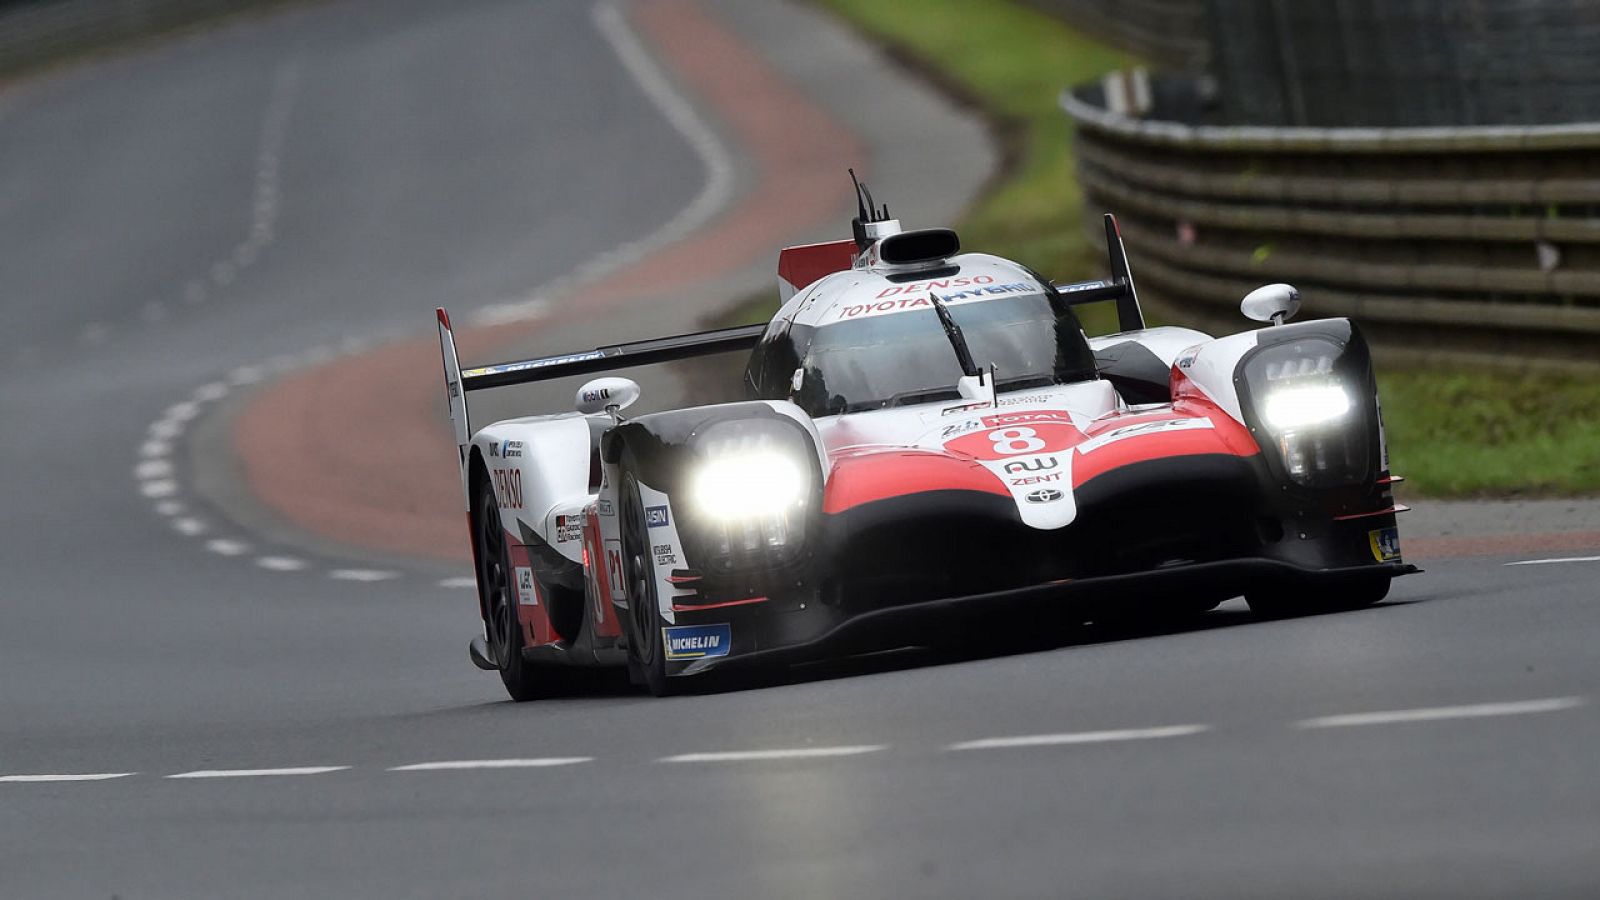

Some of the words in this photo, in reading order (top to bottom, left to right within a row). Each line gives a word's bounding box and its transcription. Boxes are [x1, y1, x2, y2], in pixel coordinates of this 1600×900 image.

[839, 297, 929, 319] TOYOTA
[939, 283, 1035, 303] HYBRID
[876, 275, 994, 300] DENSO
[987, 413, 1067, 424] TOTAL
[987, 426, 1046, 456] 8
[493, 468, 523, 510] DENSO
[1009, 470, 1063, 486] ZENT
[608, 549, 624, 591] P1
[671, 635, 720, 650] MICHELIN
